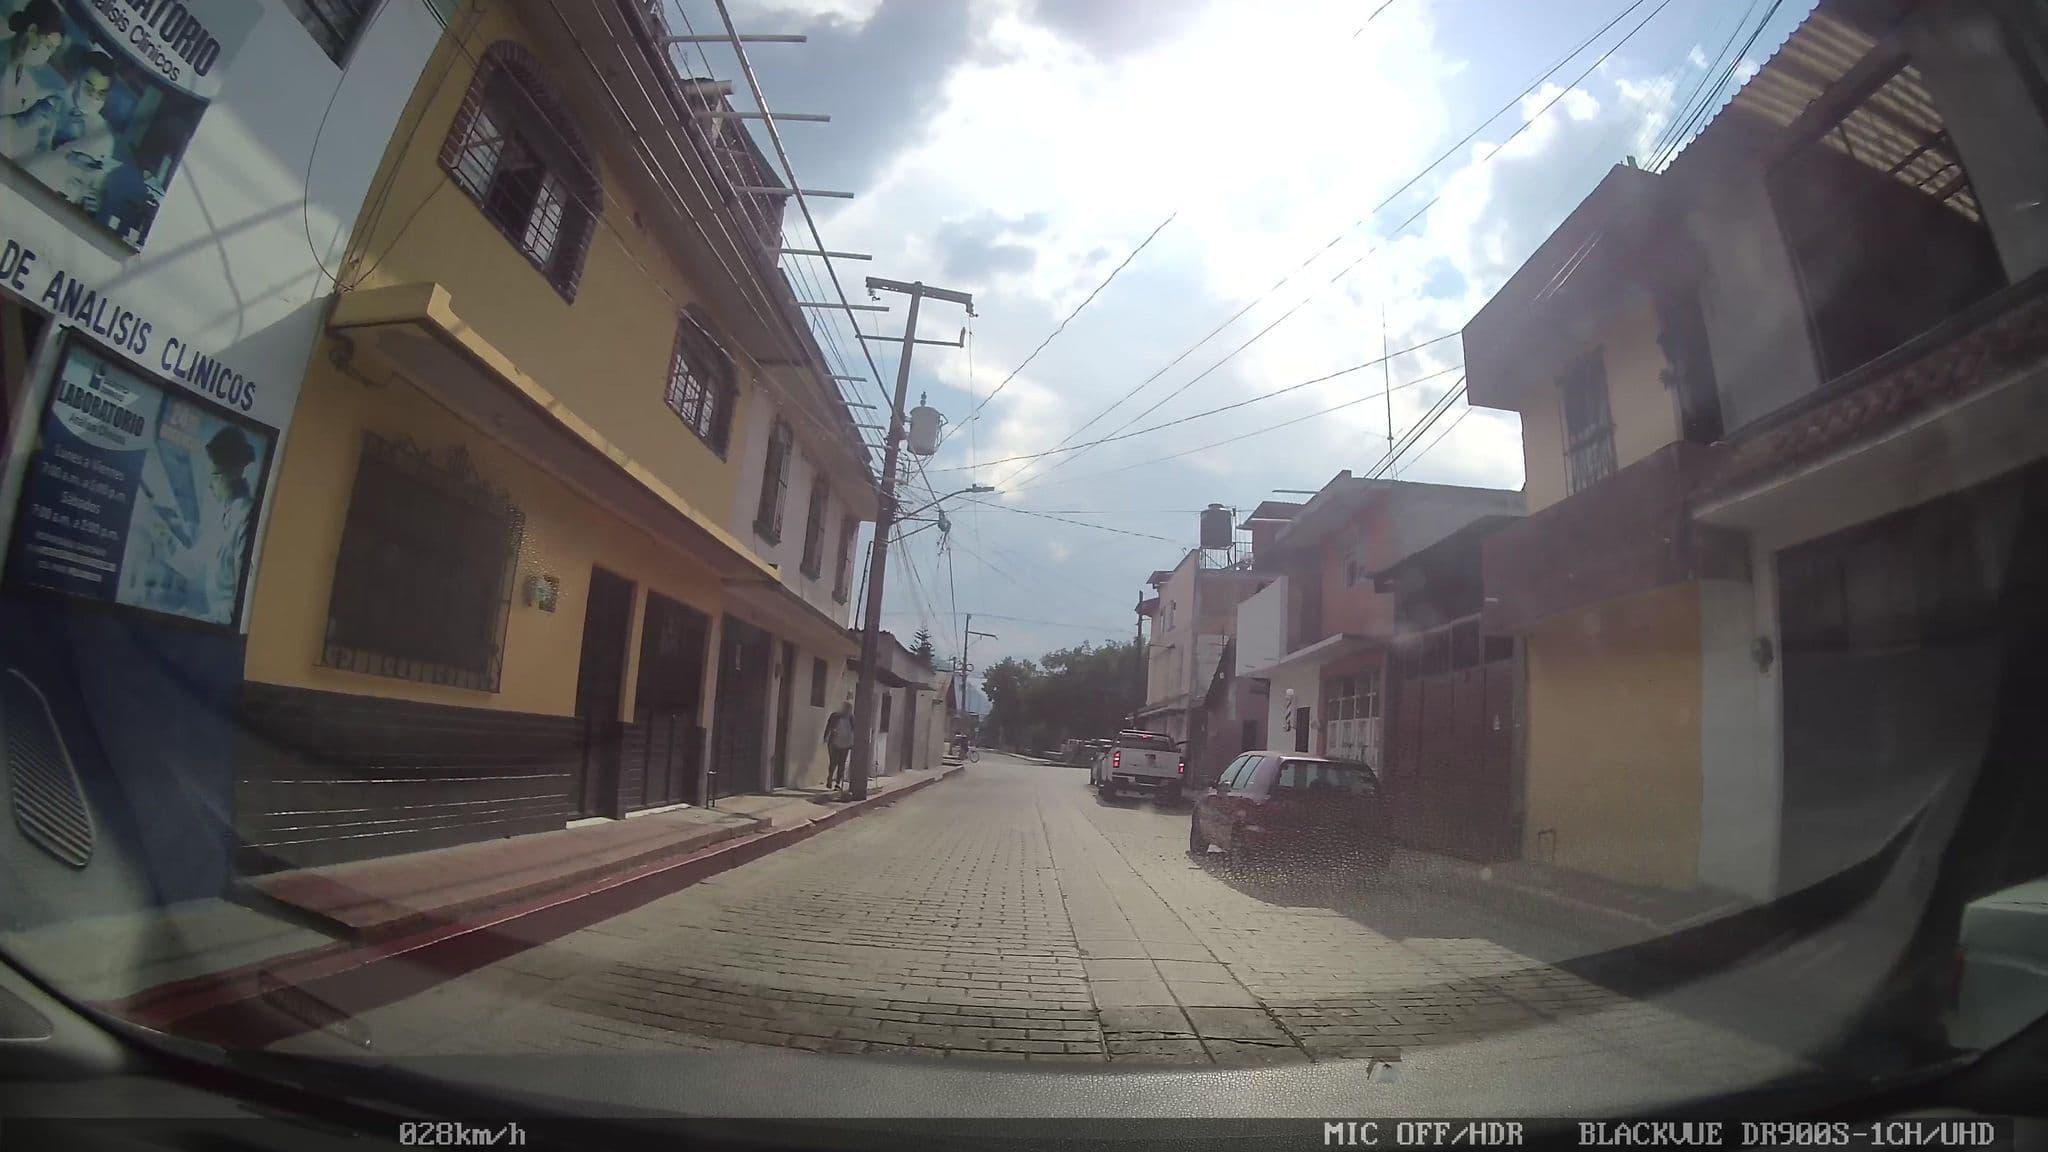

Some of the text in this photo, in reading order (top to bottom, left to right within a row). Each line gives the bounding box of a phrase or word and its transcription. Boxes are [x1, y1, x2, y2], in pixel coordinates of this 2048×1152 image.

[0, 239, 256, 412] DE ANALISIS CLINICOS
[57, 379, 146, 437] LABORATORIO
